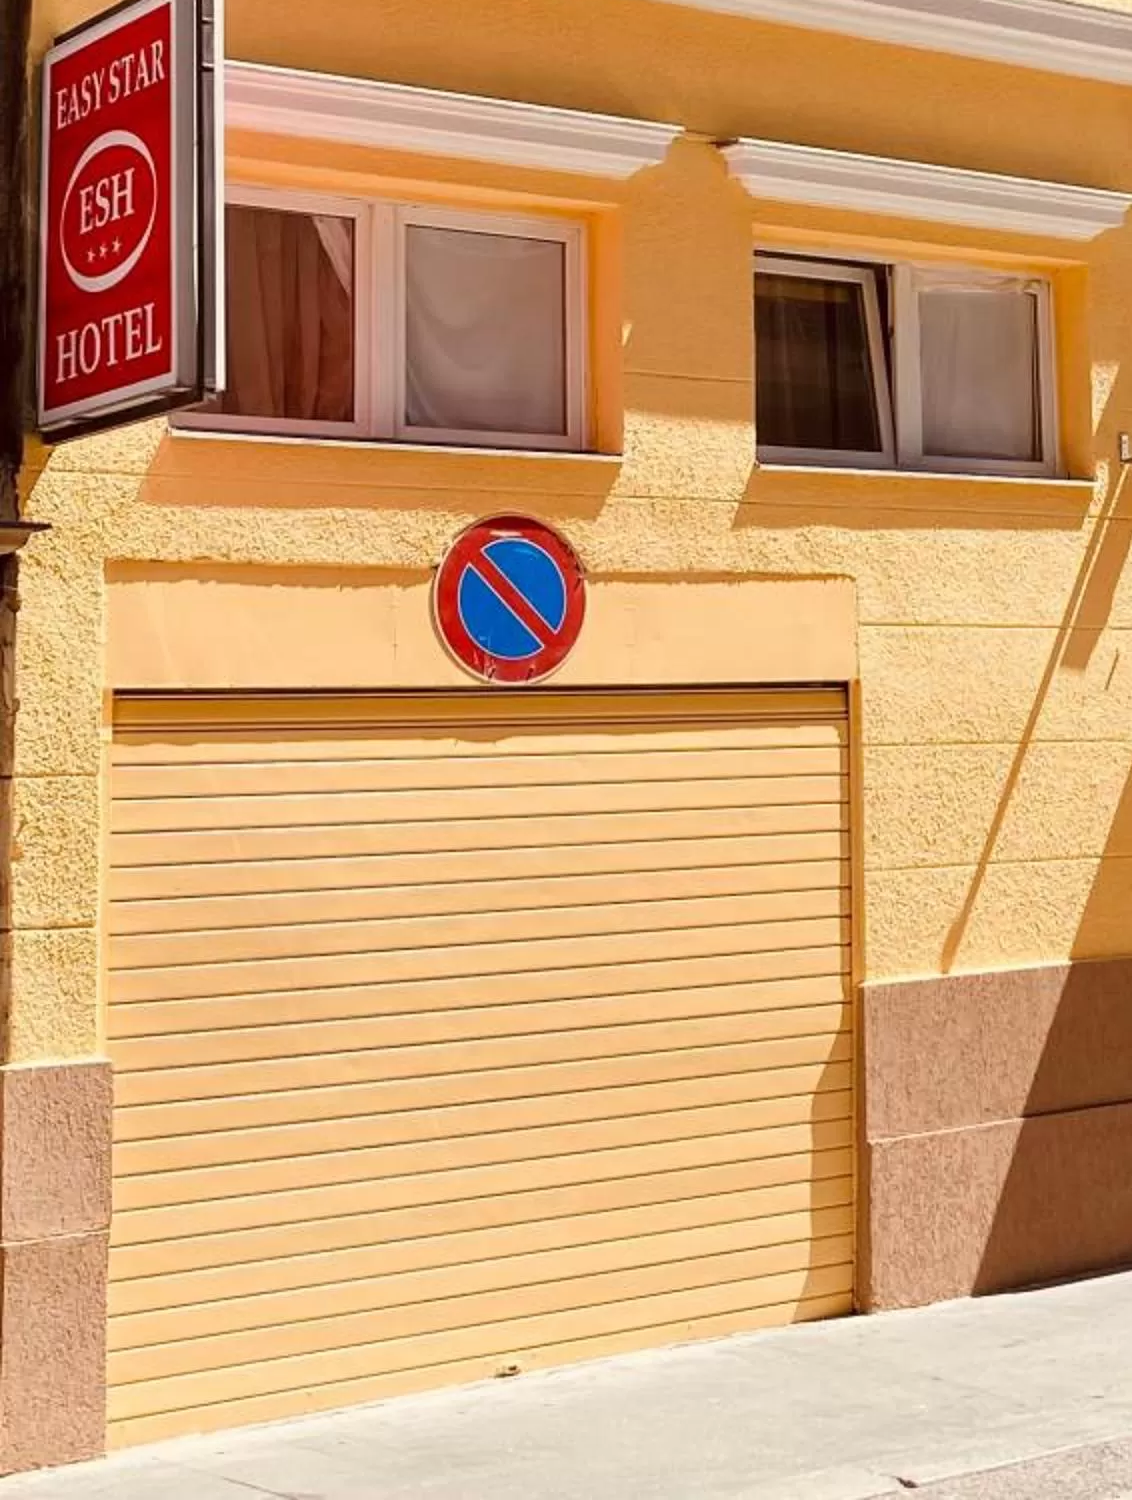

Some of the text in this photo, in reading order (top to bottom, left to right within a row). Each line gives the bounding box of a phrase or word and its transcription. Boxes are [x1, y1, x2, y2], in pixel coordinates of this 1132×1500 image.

[56, 39, 165, 130] EASY STAR
[79, 167, 136, 235] ESH
[56, 302, 162, 384] HOTEL
